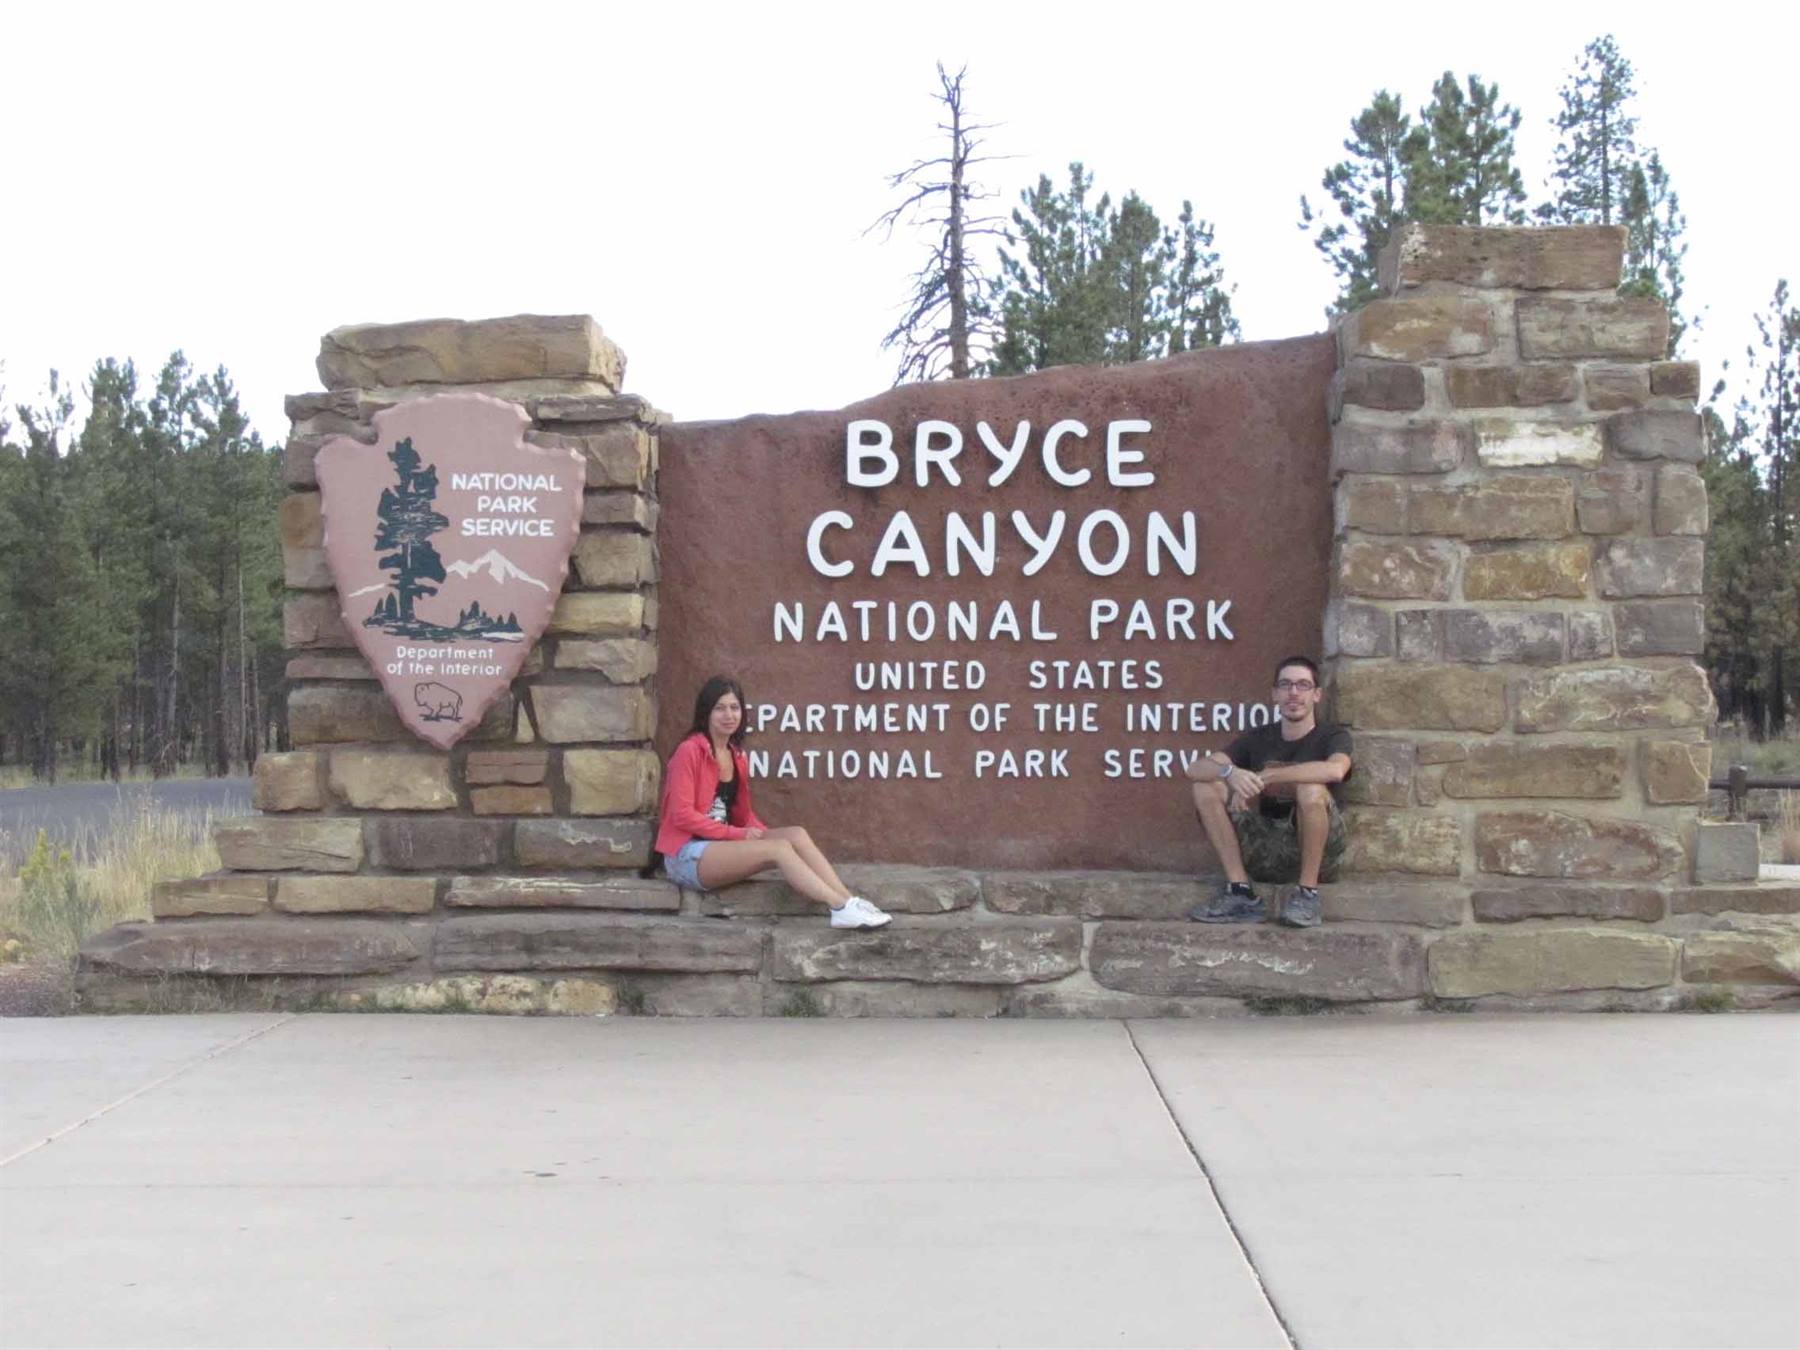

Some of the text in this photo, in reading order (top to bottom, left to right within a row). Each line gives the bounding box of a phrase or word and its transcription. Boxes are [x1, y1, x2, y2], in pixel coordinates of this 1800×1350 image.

[846, 419, 1156, 487] BRYCE
[452, 473, 563, 492] NATIONAL
[477, 495, 537, 513] PARK
[461, 518, 554, 537] SERVICE
[806, 509, 1198, 577] CANYON
[774, 598, 1235, 642] NATIONAL PARK
[396, 645, 494, 661] Department
[387, 662, 404, 675] of
[409, 662, 434, 674] the
[855, 660, 1164, 690] UNITED STATES
[745, 703, 949, 733] PARTMENT
[970, 703, 1011, 732] OF
[1034, 703, 1099, 732] THE
[749, 748, 1211, 778] NATIONAL PARK SERV
